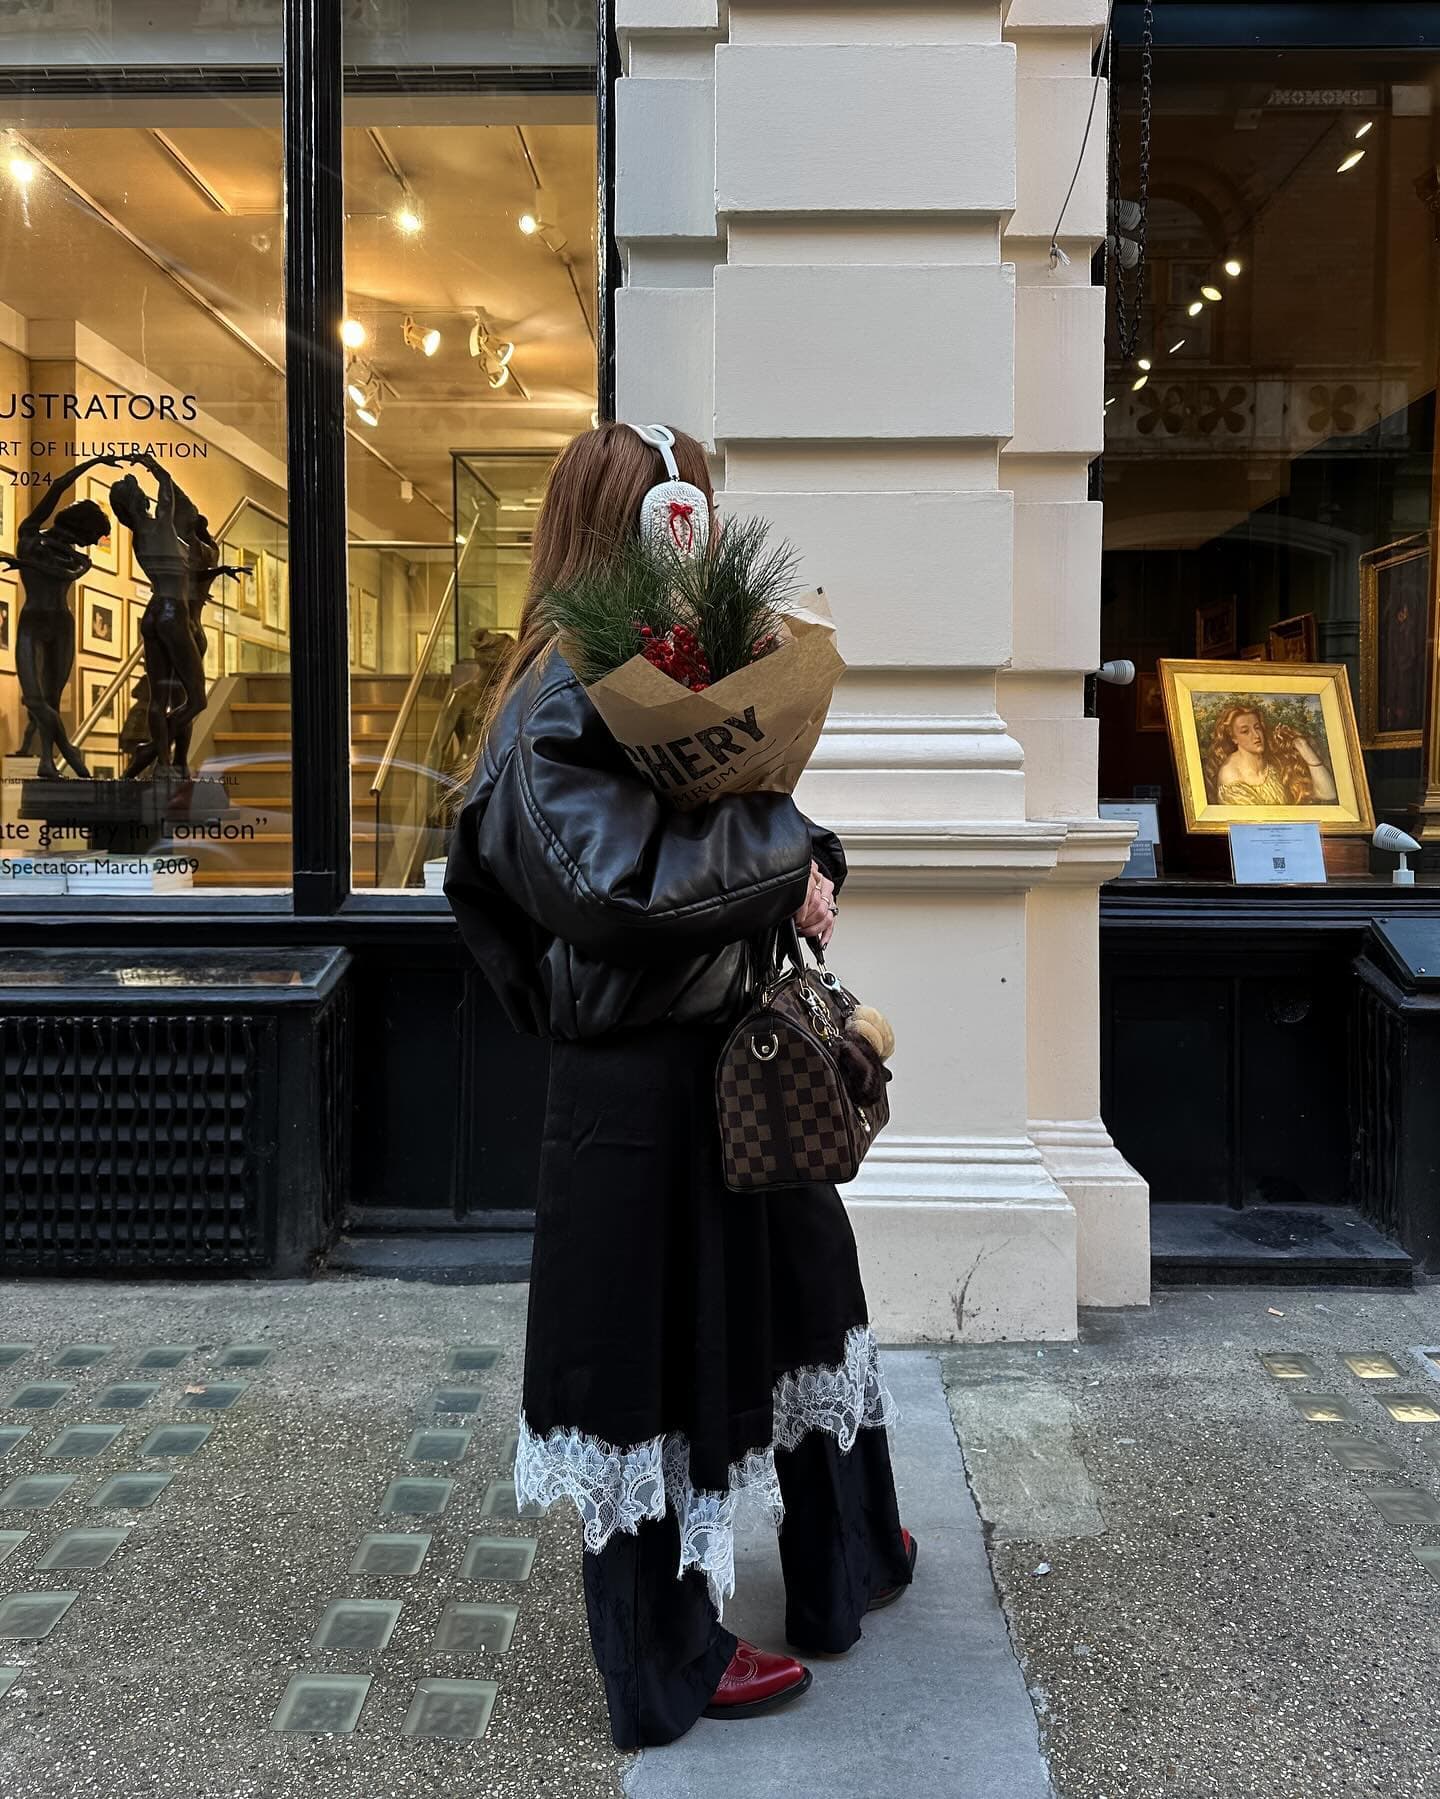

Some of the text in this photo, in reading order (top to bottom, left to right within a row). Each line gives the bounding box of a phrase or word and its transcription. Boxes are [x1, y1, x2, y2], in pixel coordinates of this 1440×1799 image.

[30, 441, 57, 457] OF
[65, 441, 208, 458] ILLUSTRATION
[10, 471, 53, 487] 2024
[0, 822, 30, 840] te
[38, 819, 117, 847] gallery
[129, 820, 150, 840] in
[2, 857, 200, 879] Spectator, March 2009
